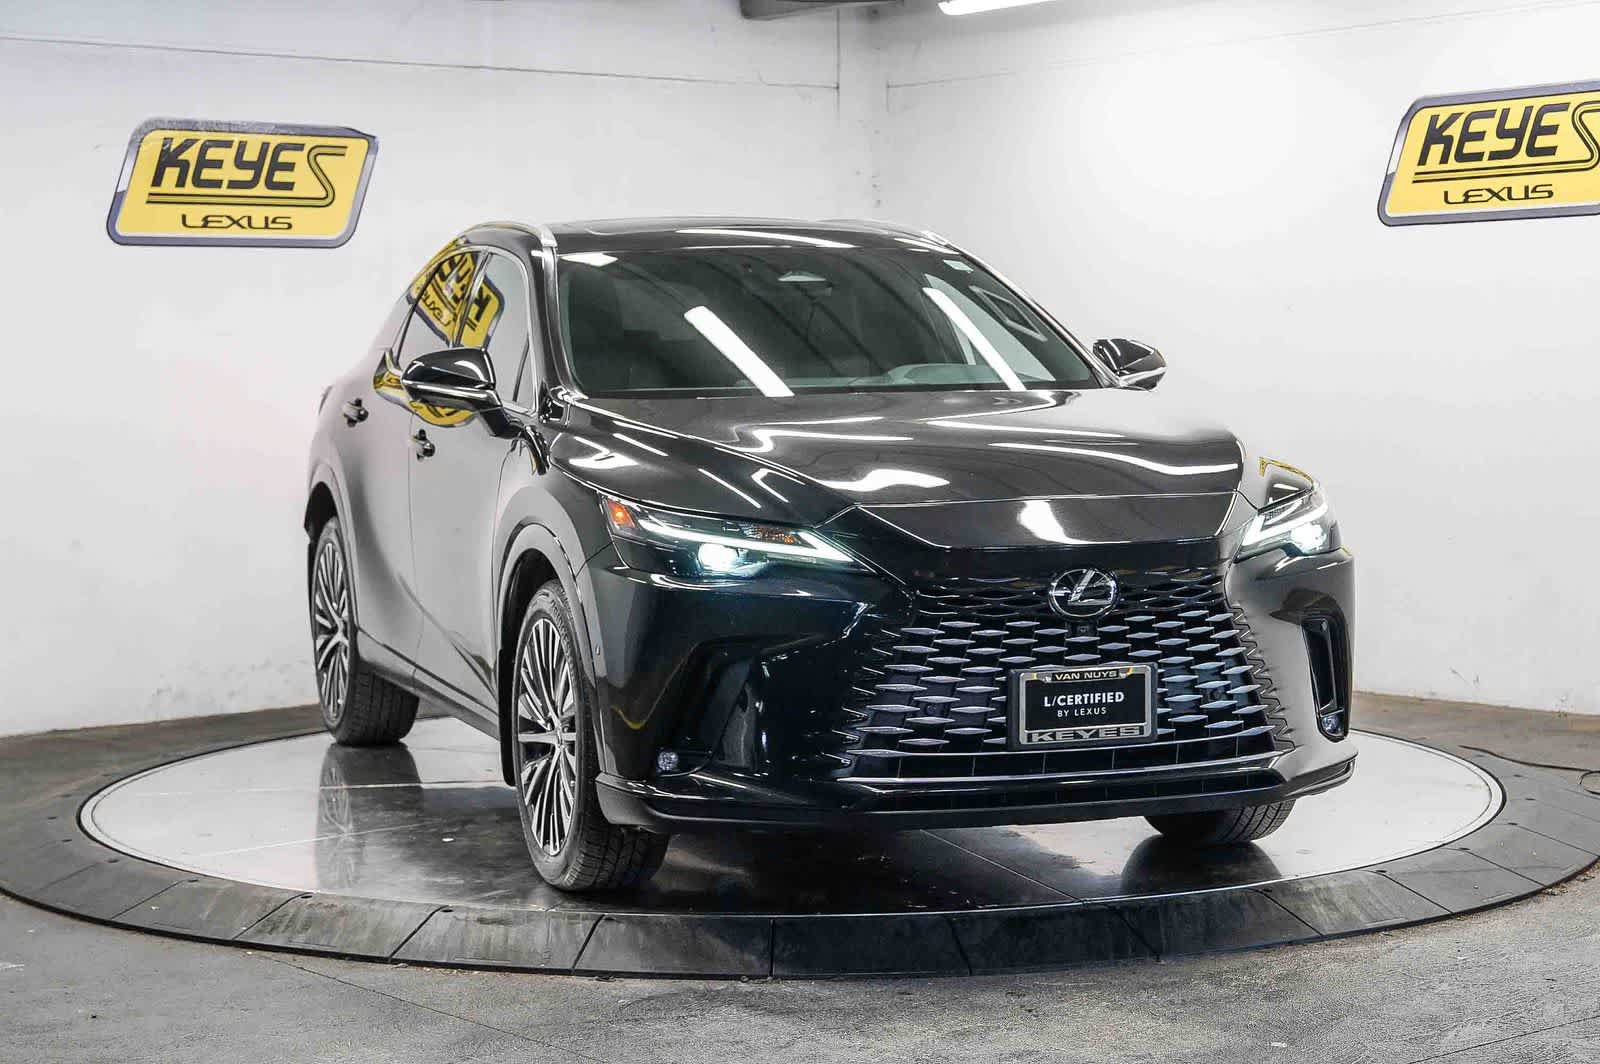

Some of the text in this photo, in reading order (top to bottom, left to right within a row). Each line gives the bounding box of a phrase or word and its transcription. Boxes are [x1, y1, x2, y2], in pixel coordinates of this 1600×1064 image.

[147, 137, 348, 207] KEYES
[1443, 184, 1554, 205] LEXUS
[181, 214, 293, 230] LEXUS
[1055, 670, 1118, 681] VAN NUYS
[1044, 691, 1125, 707] L/CERTIFIED
[1057, 707, 1107, 718] BY LEXUS
[1031, 726, 1140, 742] KEYES
